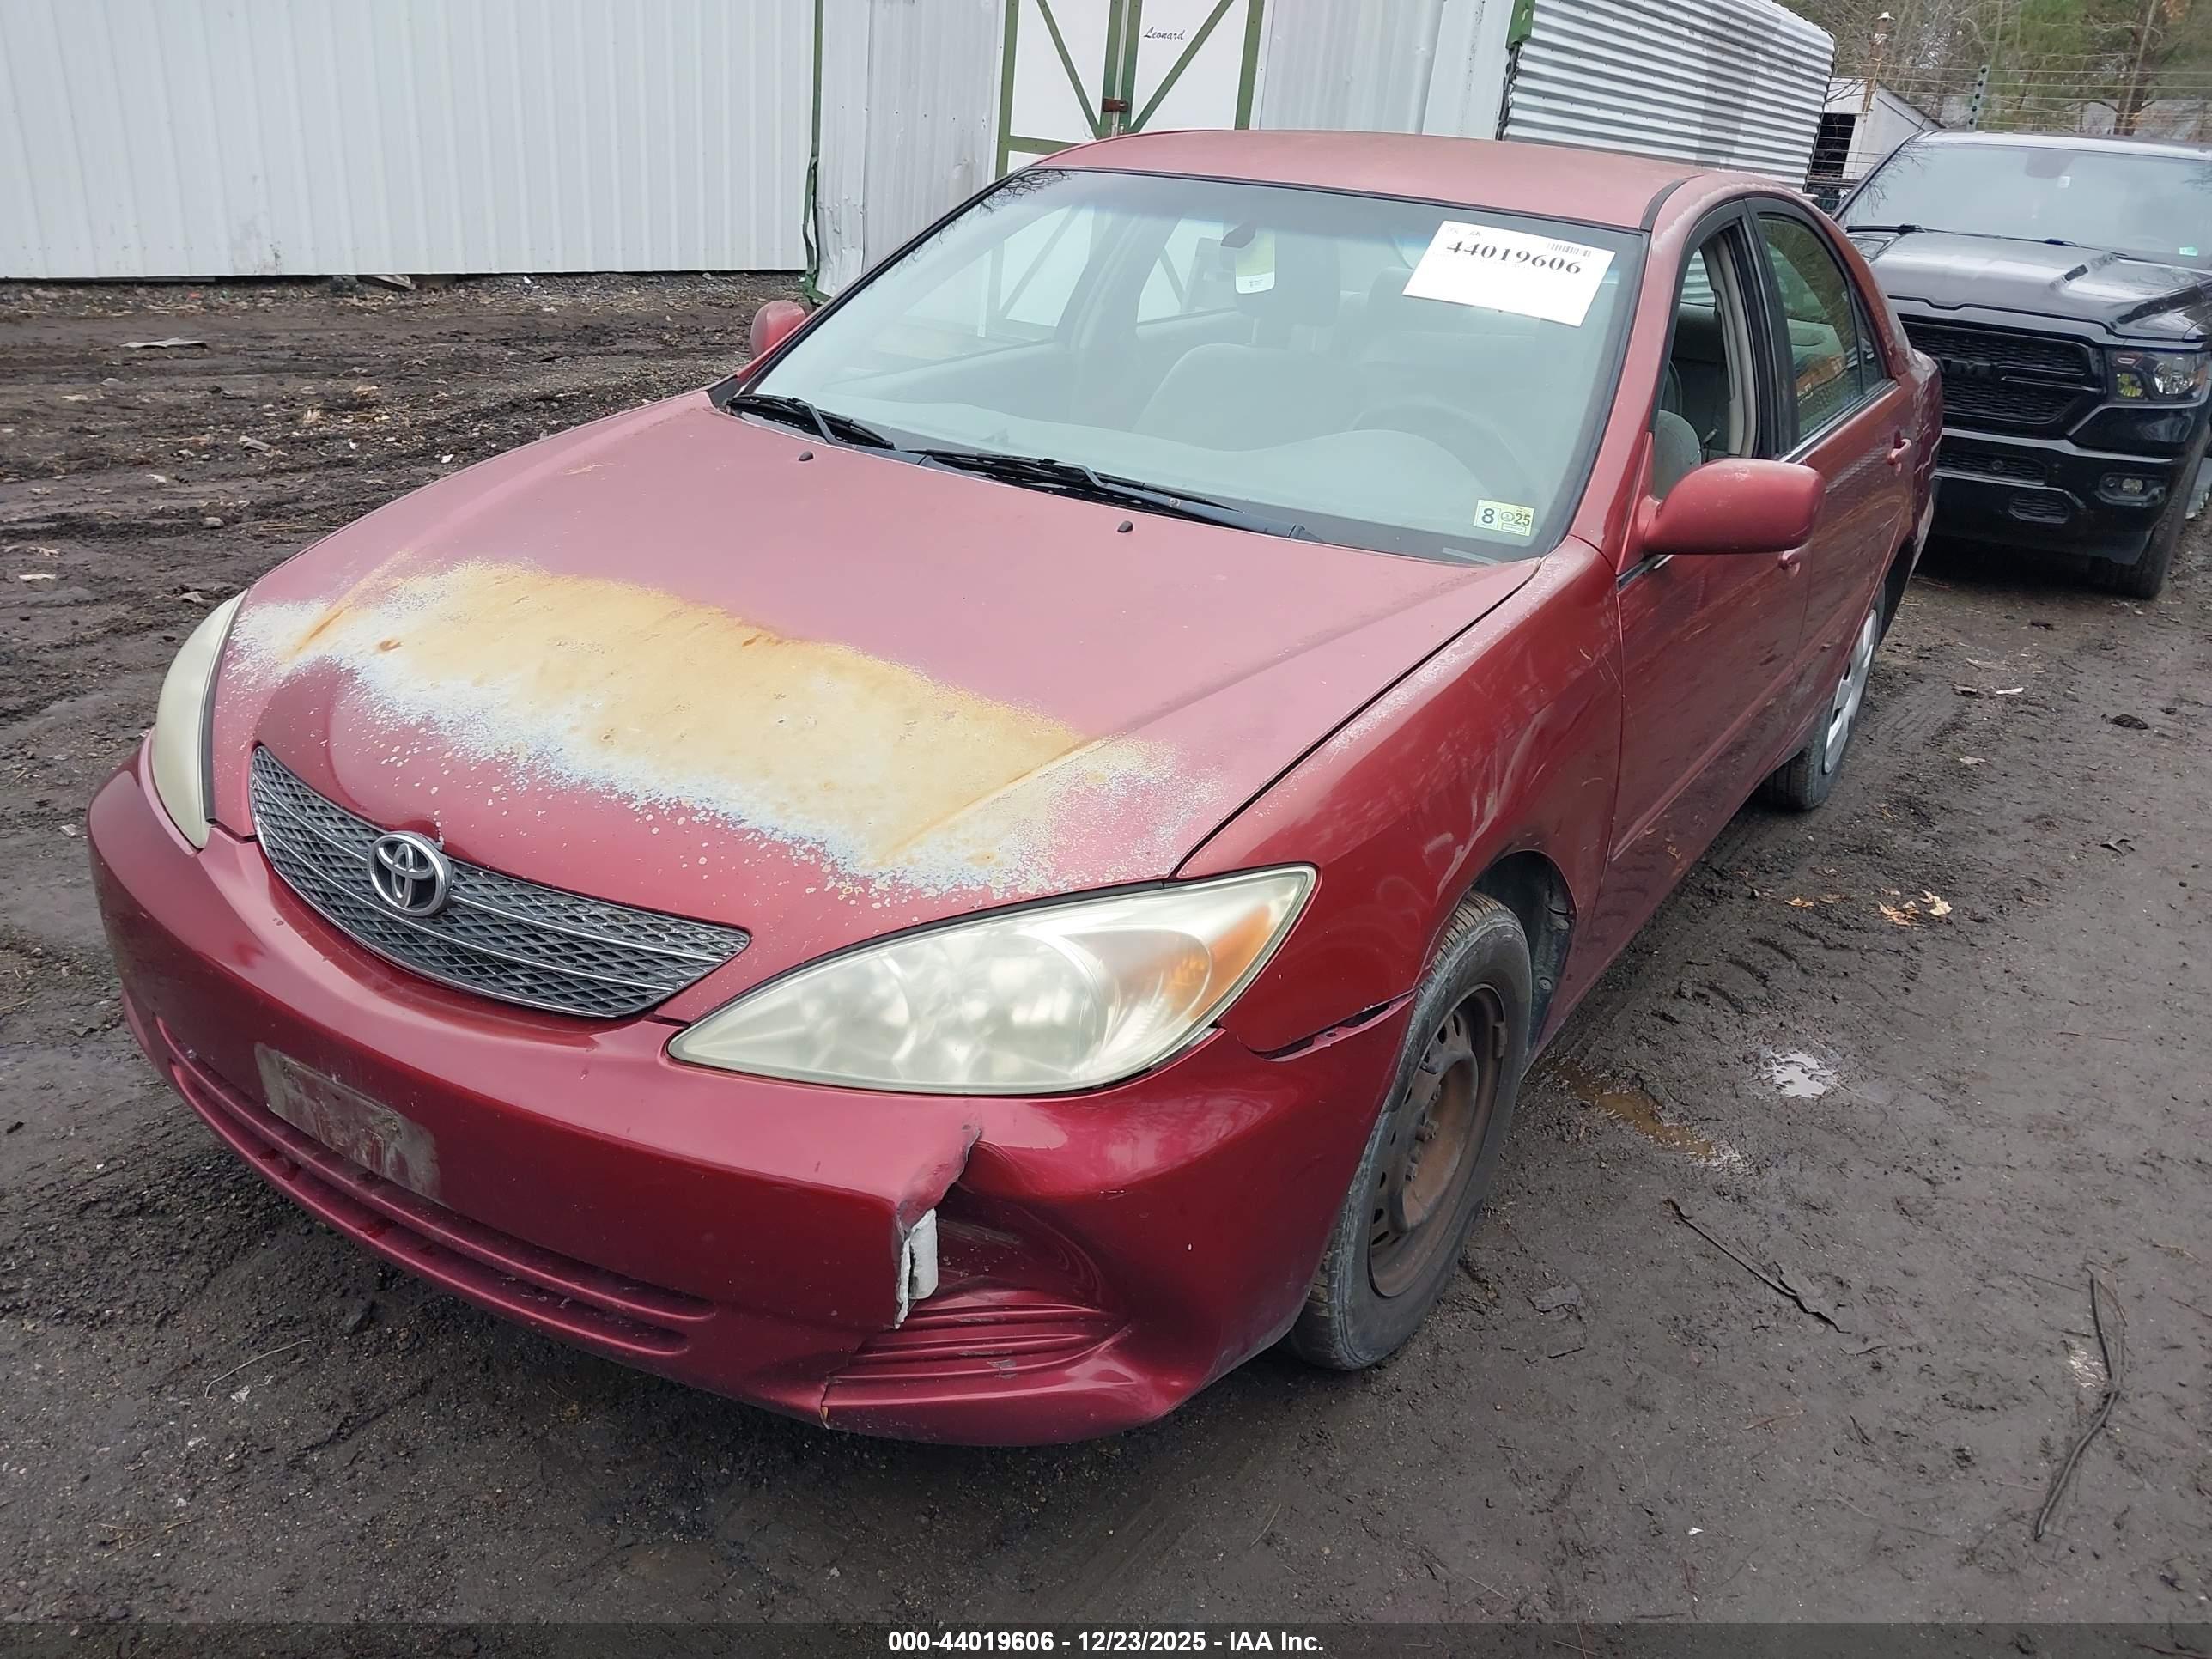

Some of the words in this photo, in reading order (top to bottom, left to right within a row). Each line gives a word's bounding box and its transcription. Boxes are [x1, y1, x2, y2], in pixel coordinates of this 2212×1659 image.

[1144, 27, 1186, 40] Leonard
[1446, 241, 1582, 274] 44019606
[1481, 507, 1495, 524] 8
[1514, 513, 1531, 526] 25
